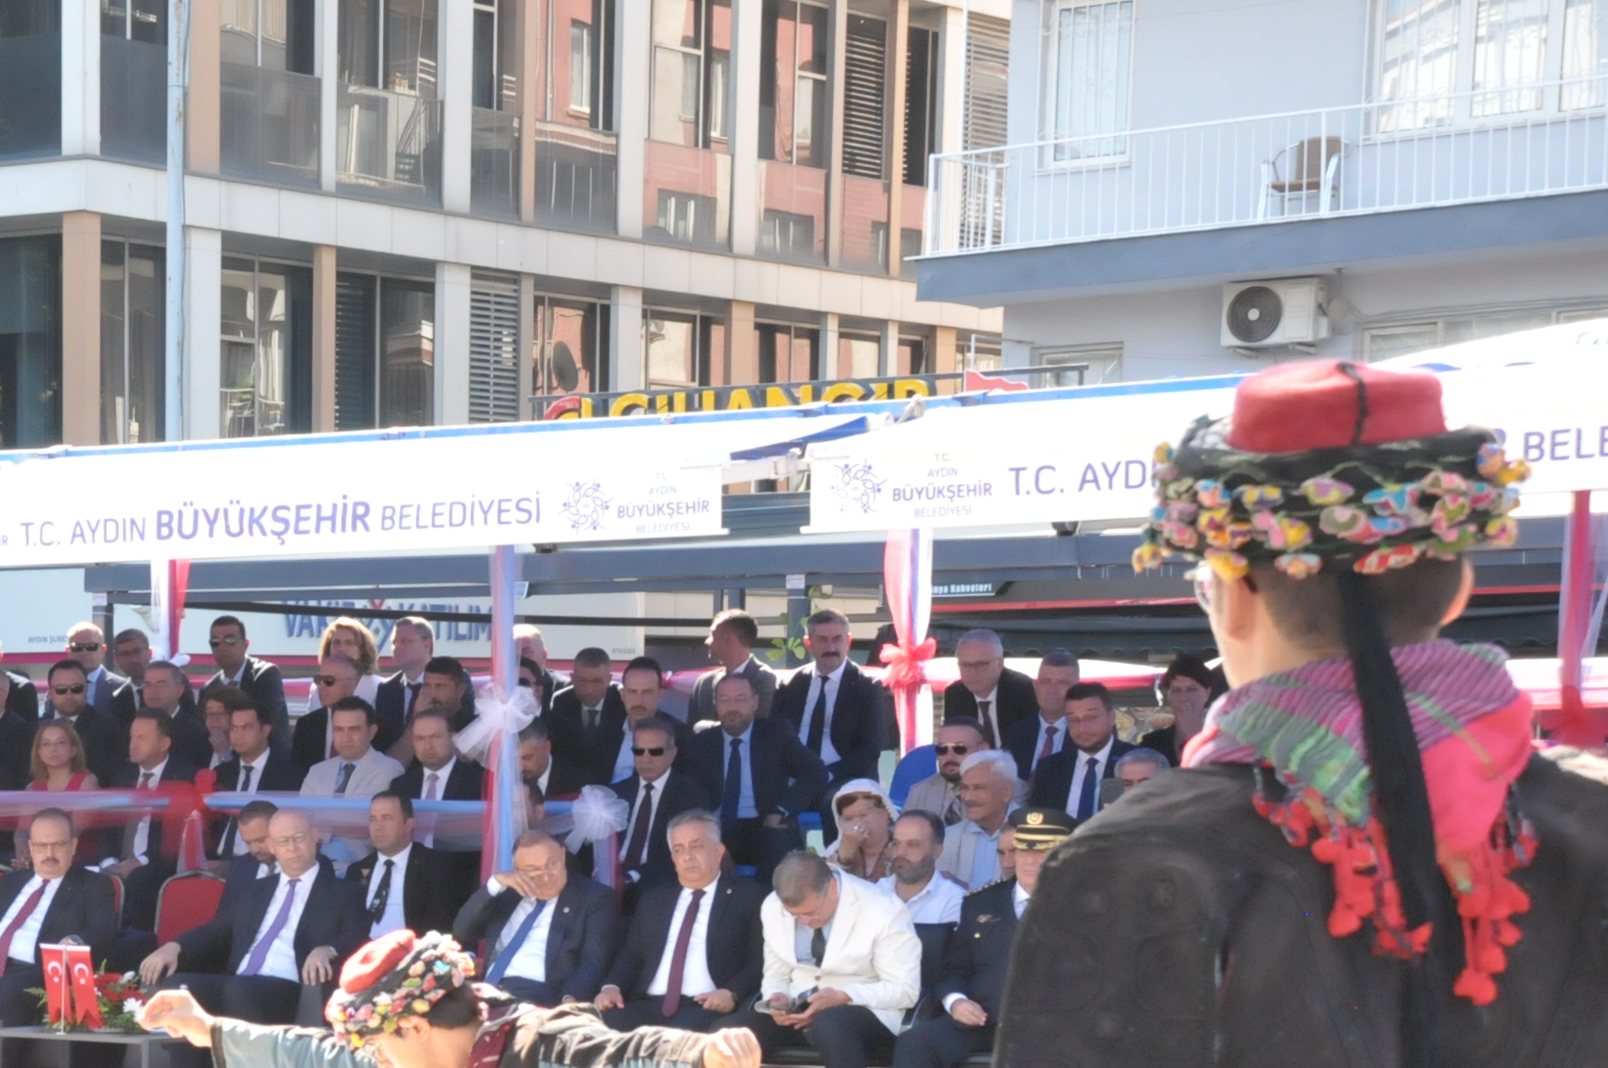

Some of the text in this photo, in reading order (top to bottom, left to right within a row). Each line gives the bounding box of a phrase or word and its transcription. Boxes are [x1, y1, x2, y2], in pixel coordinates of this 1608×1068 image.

[927, 466, 959, 478] AYDIN
[1007, 459, 1158, 496] T.C. AYDI
[648, 485, 677, 496] AYDIN
[891, 479, 993, 503] BÜYÜKŞEHİR
[19, 490, 542, 547] T.C. AYDIN BÜYÜKŞEHİR BELEDİYESİ
[617, 497, 710, 520] BÜYÜKŞEHİR
[913, 505, 973, 519] BELEDİYESİ
[283, 600, 356, 638] VAK
